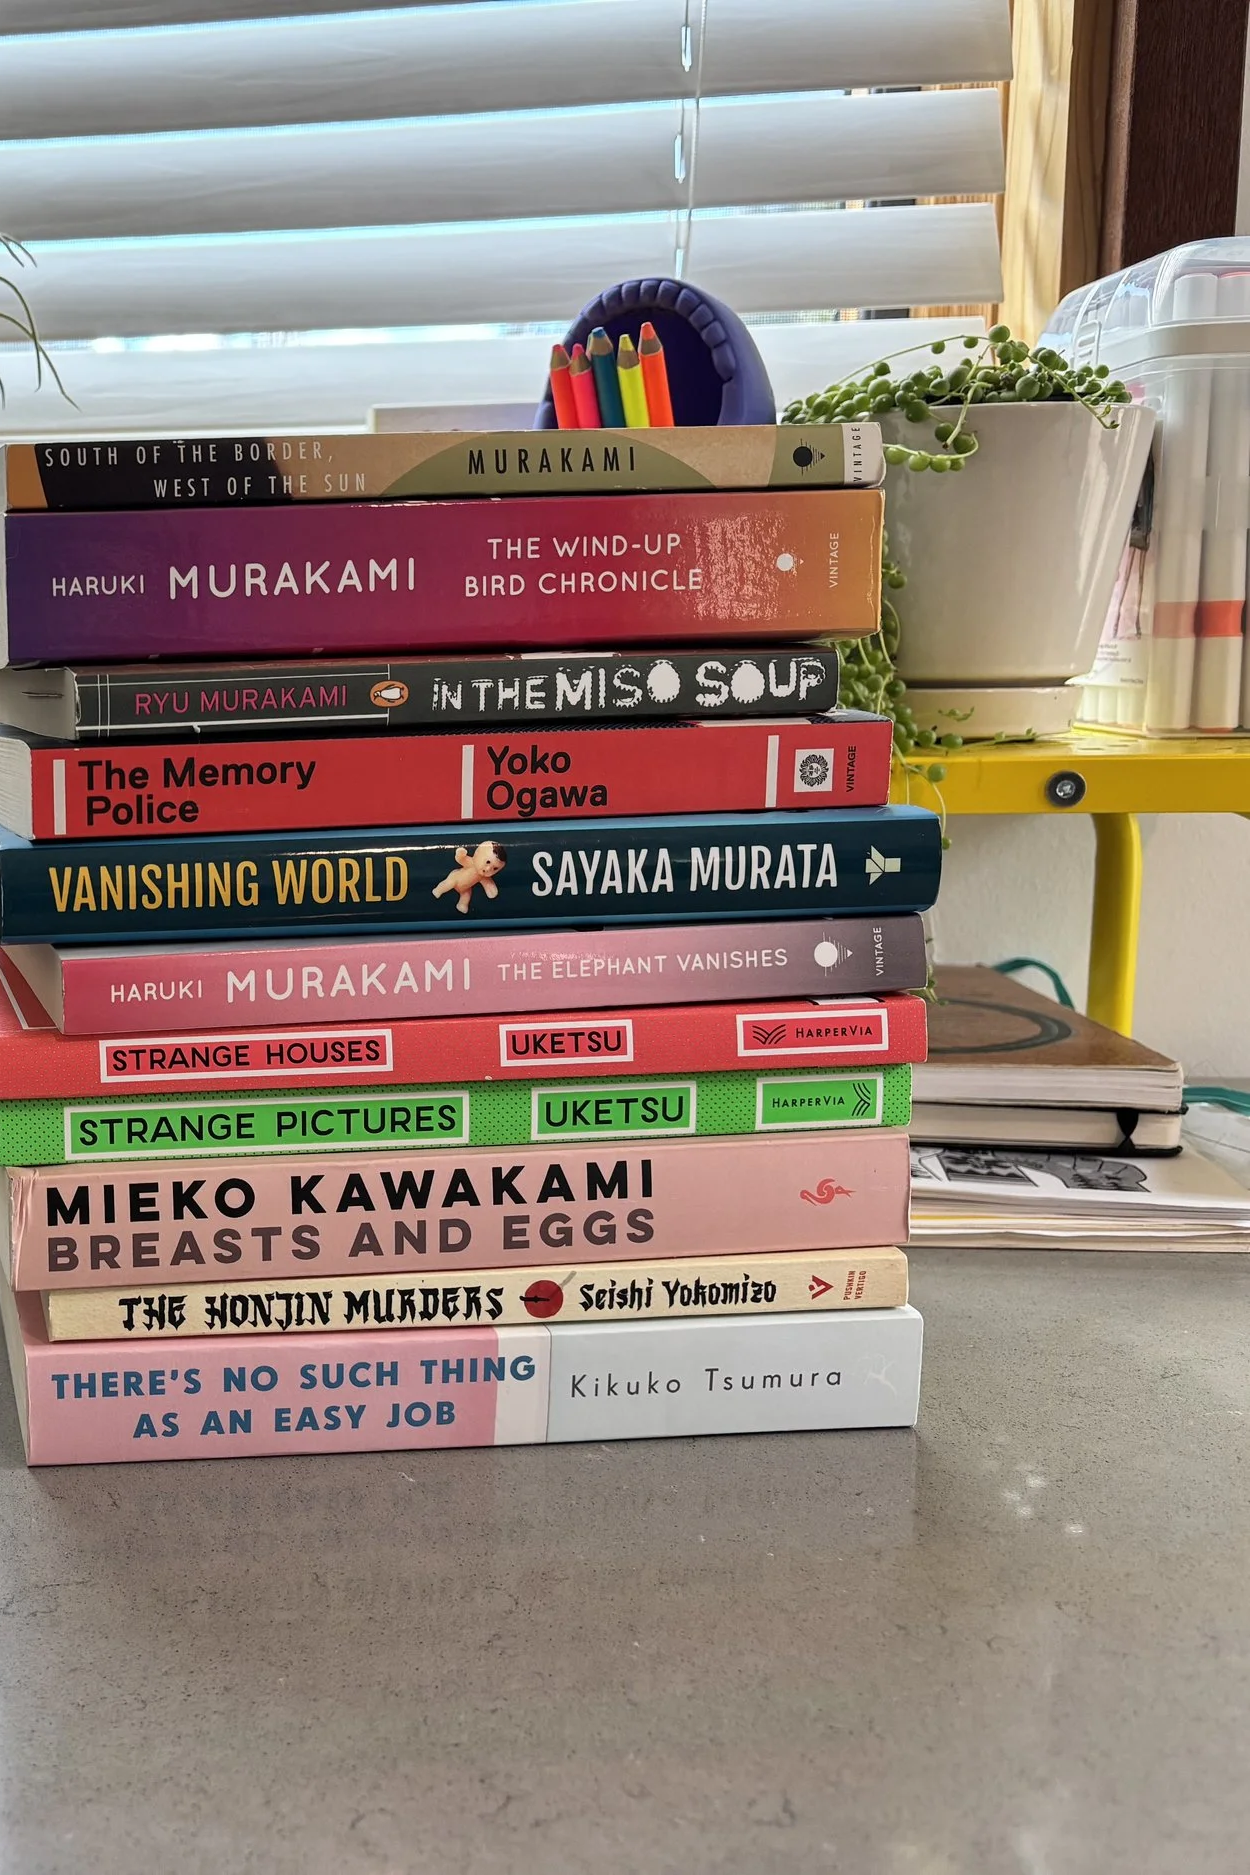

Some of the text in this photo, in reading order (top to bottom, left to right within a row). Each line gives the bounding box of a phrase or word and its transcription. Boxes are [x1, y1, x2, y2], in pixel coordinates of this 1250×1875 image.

[45, 441, 333, 467] SOUTH OF THE BORDER,
[468, 447, 636, 475] MURAKAMI
[851, 427, 862, 482] VINTAGE
[154, 473, 365, 498] WEST OF THE SUN
[487, 533, 681, 560] THE WIND-UP
[829, 532, 839, 588] VINTAGE
[52, 557, 415, 600] HARUKI MURAKAMI
[465, 568, 702, 597] BIRD CHRONICLE
[135, 685, 347, 716] RYU MURAKAMI
[432, 657, 826, 711] IN THE MISO SOUP
[79, 758, 316, 790] The Memory
[487, 745, 571, 776] Yoko
[846, 746, 857, 792] VINTAGE
[86, 796, 199, 826] Police
[486, 780, 608, 818] Ogawa
[49, 857, 408, 913] VANISHING WORLD
[532, 843, 837, 897] SAYAKA MURATA
[498, 948, 788, 982] THE ELEPHANT VANISHES
[874, 926, 884, 977] VINTAGE
[111, 957, 470, 1003] HARUKI MURAKAMI
[112, 1039, 381, 1071] STRANGE HOUSES
[511, 1031, 622, 1055] UKETSU
[79, 1105, 456, 1147] STRANGE PICTURES
[545, 1096, 683, 1127] UKETSU
[47, 1159, 652, 1227] MIEKO KAWAKAMI
[48, 1208, 655, 1273] BREASTS AND EGGS
[579, 1273, 777, 1312] Seishi Yokomizo
[843, 1270, 856, 1300] PUSHKIN
[854, 1270, 867, 1300] VERTIGO
[119, 1285, 503, 1332] THE HONJIN MURDERS
[51, 1355, 536, 1400] THERE'S NO SUCH THING
[571, 1367, 841, 1398] Kikuko Tsumura
[133, 1400, 456, 1438] AS AN EASY JOB
